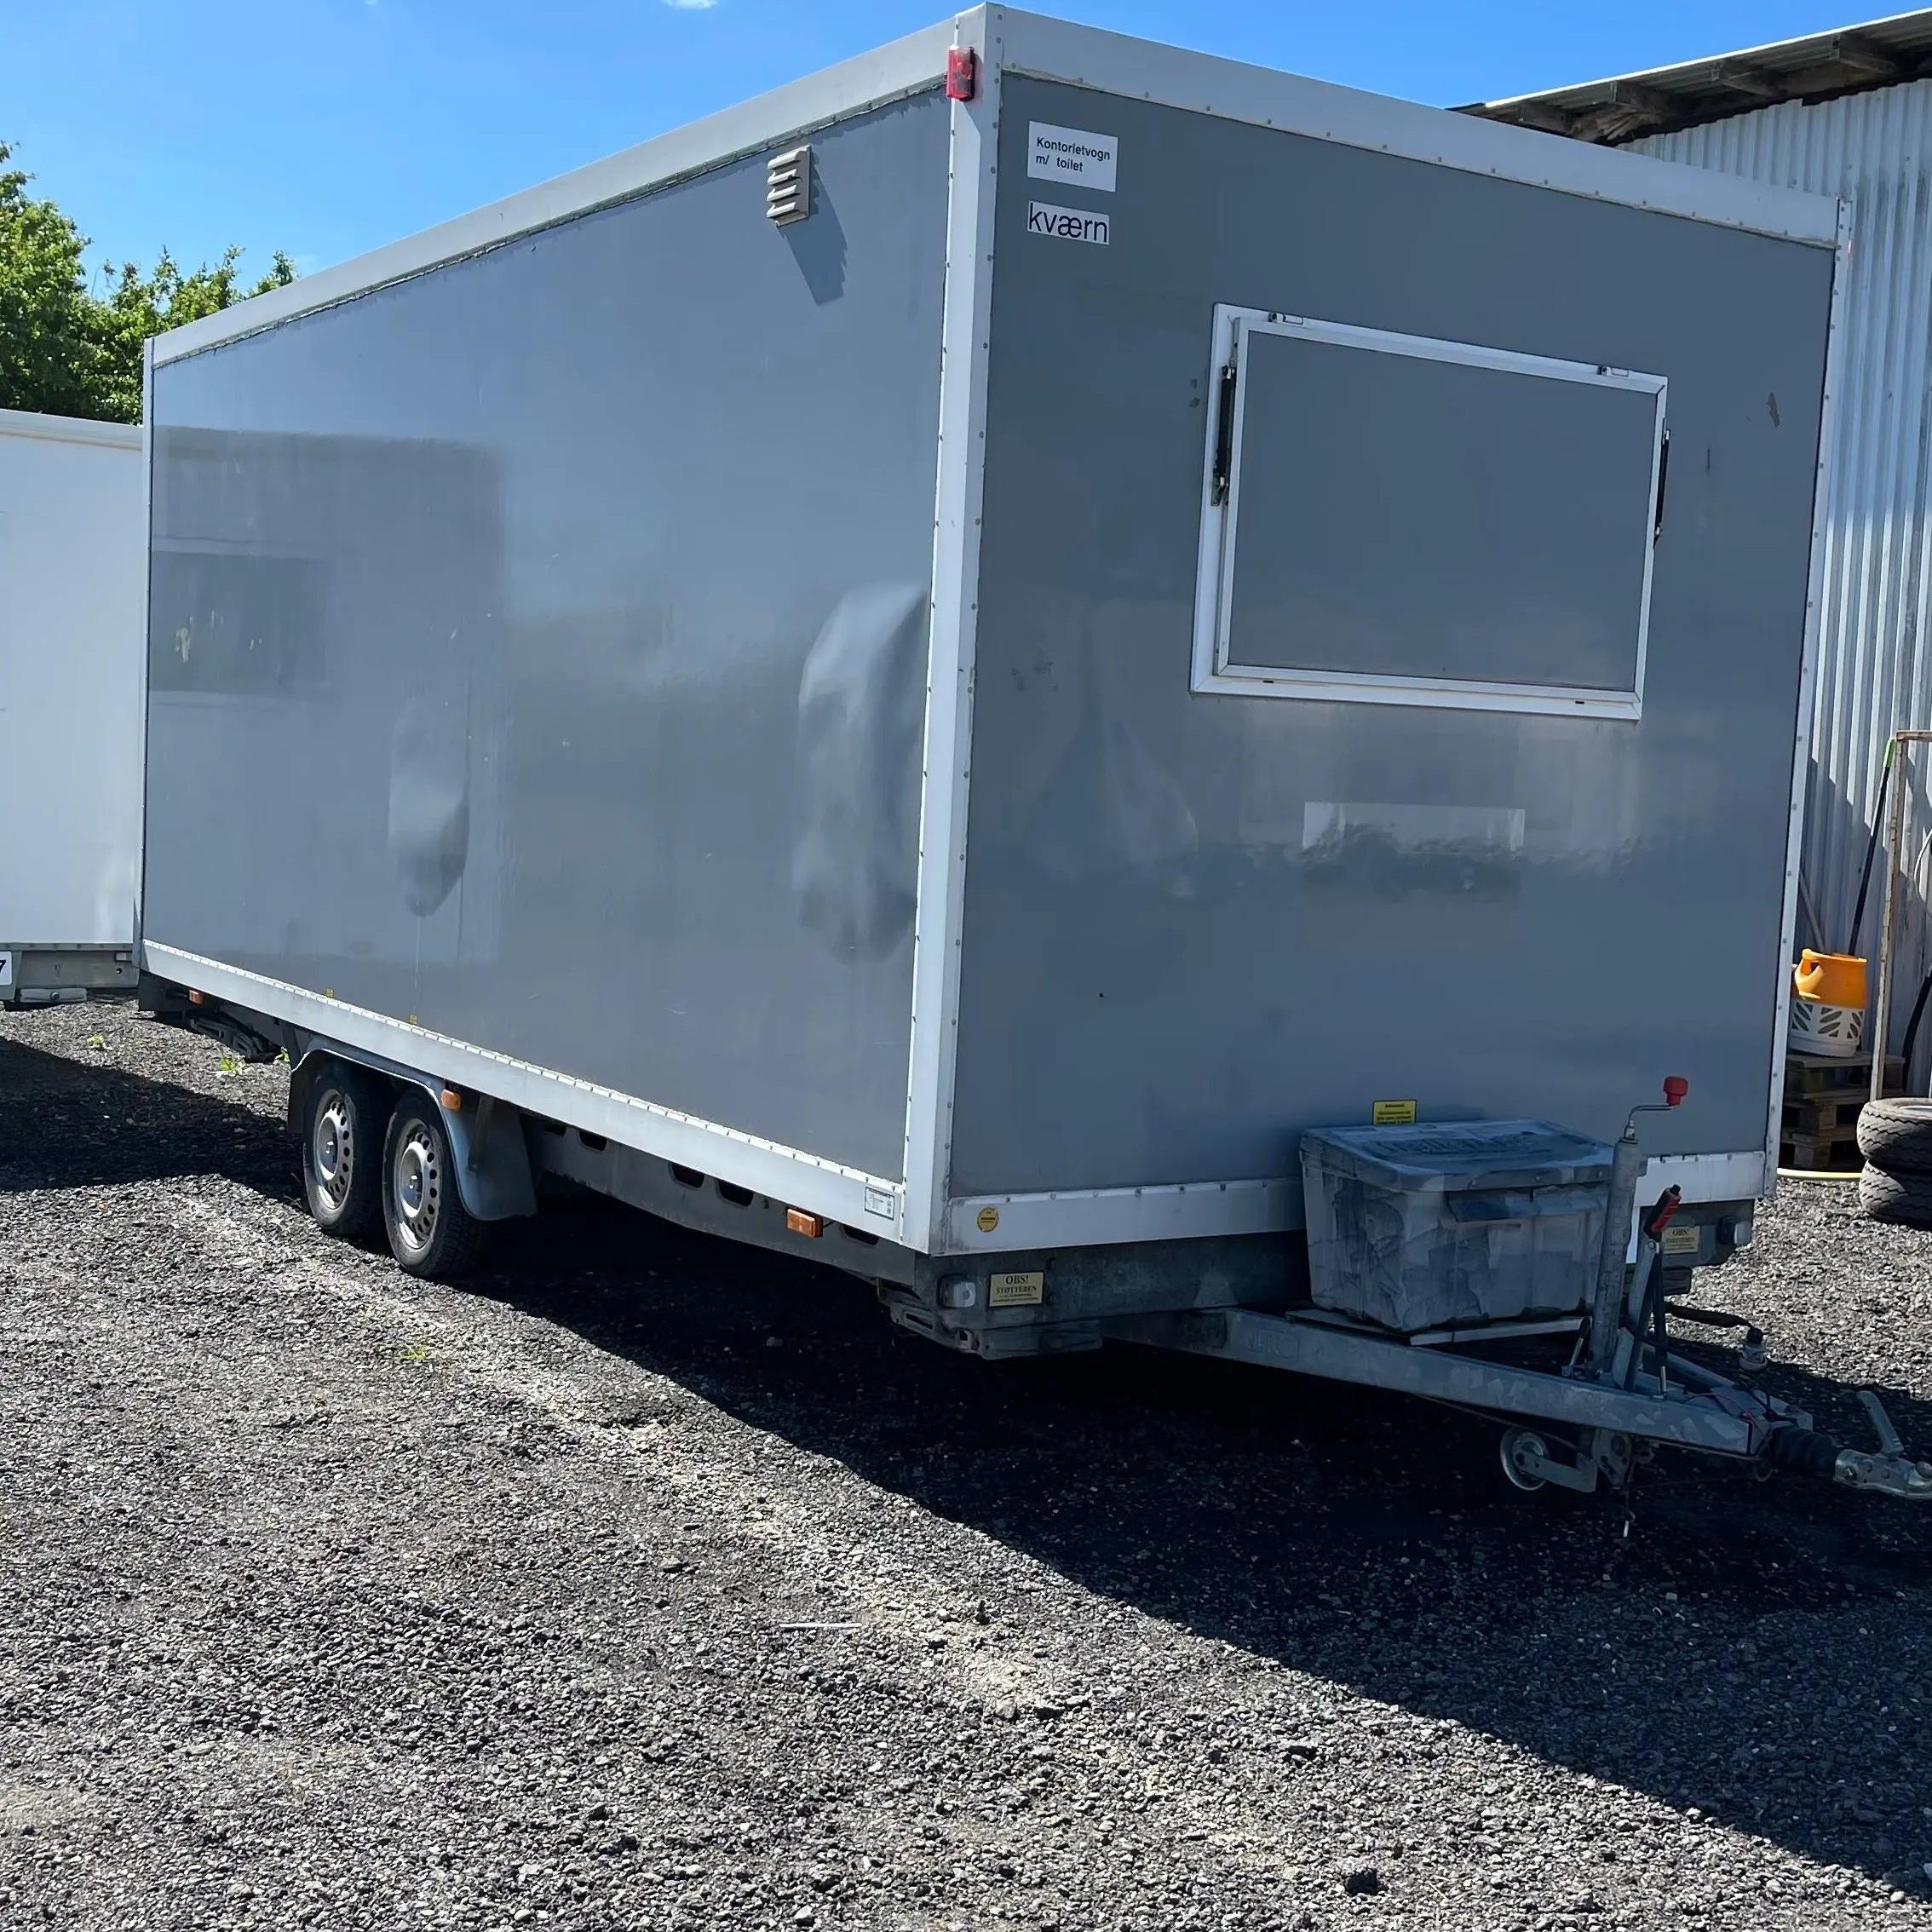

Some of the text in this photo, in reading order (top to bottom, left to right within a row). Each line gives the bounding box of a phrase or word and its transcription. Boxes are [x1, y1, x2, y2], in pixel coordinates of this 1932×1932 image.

[1035, 154, 1083, 172] m/ toilet
[1028, 202, 1107, 243] kværn
[1005, 1274, 1029, 1285] OBS!
